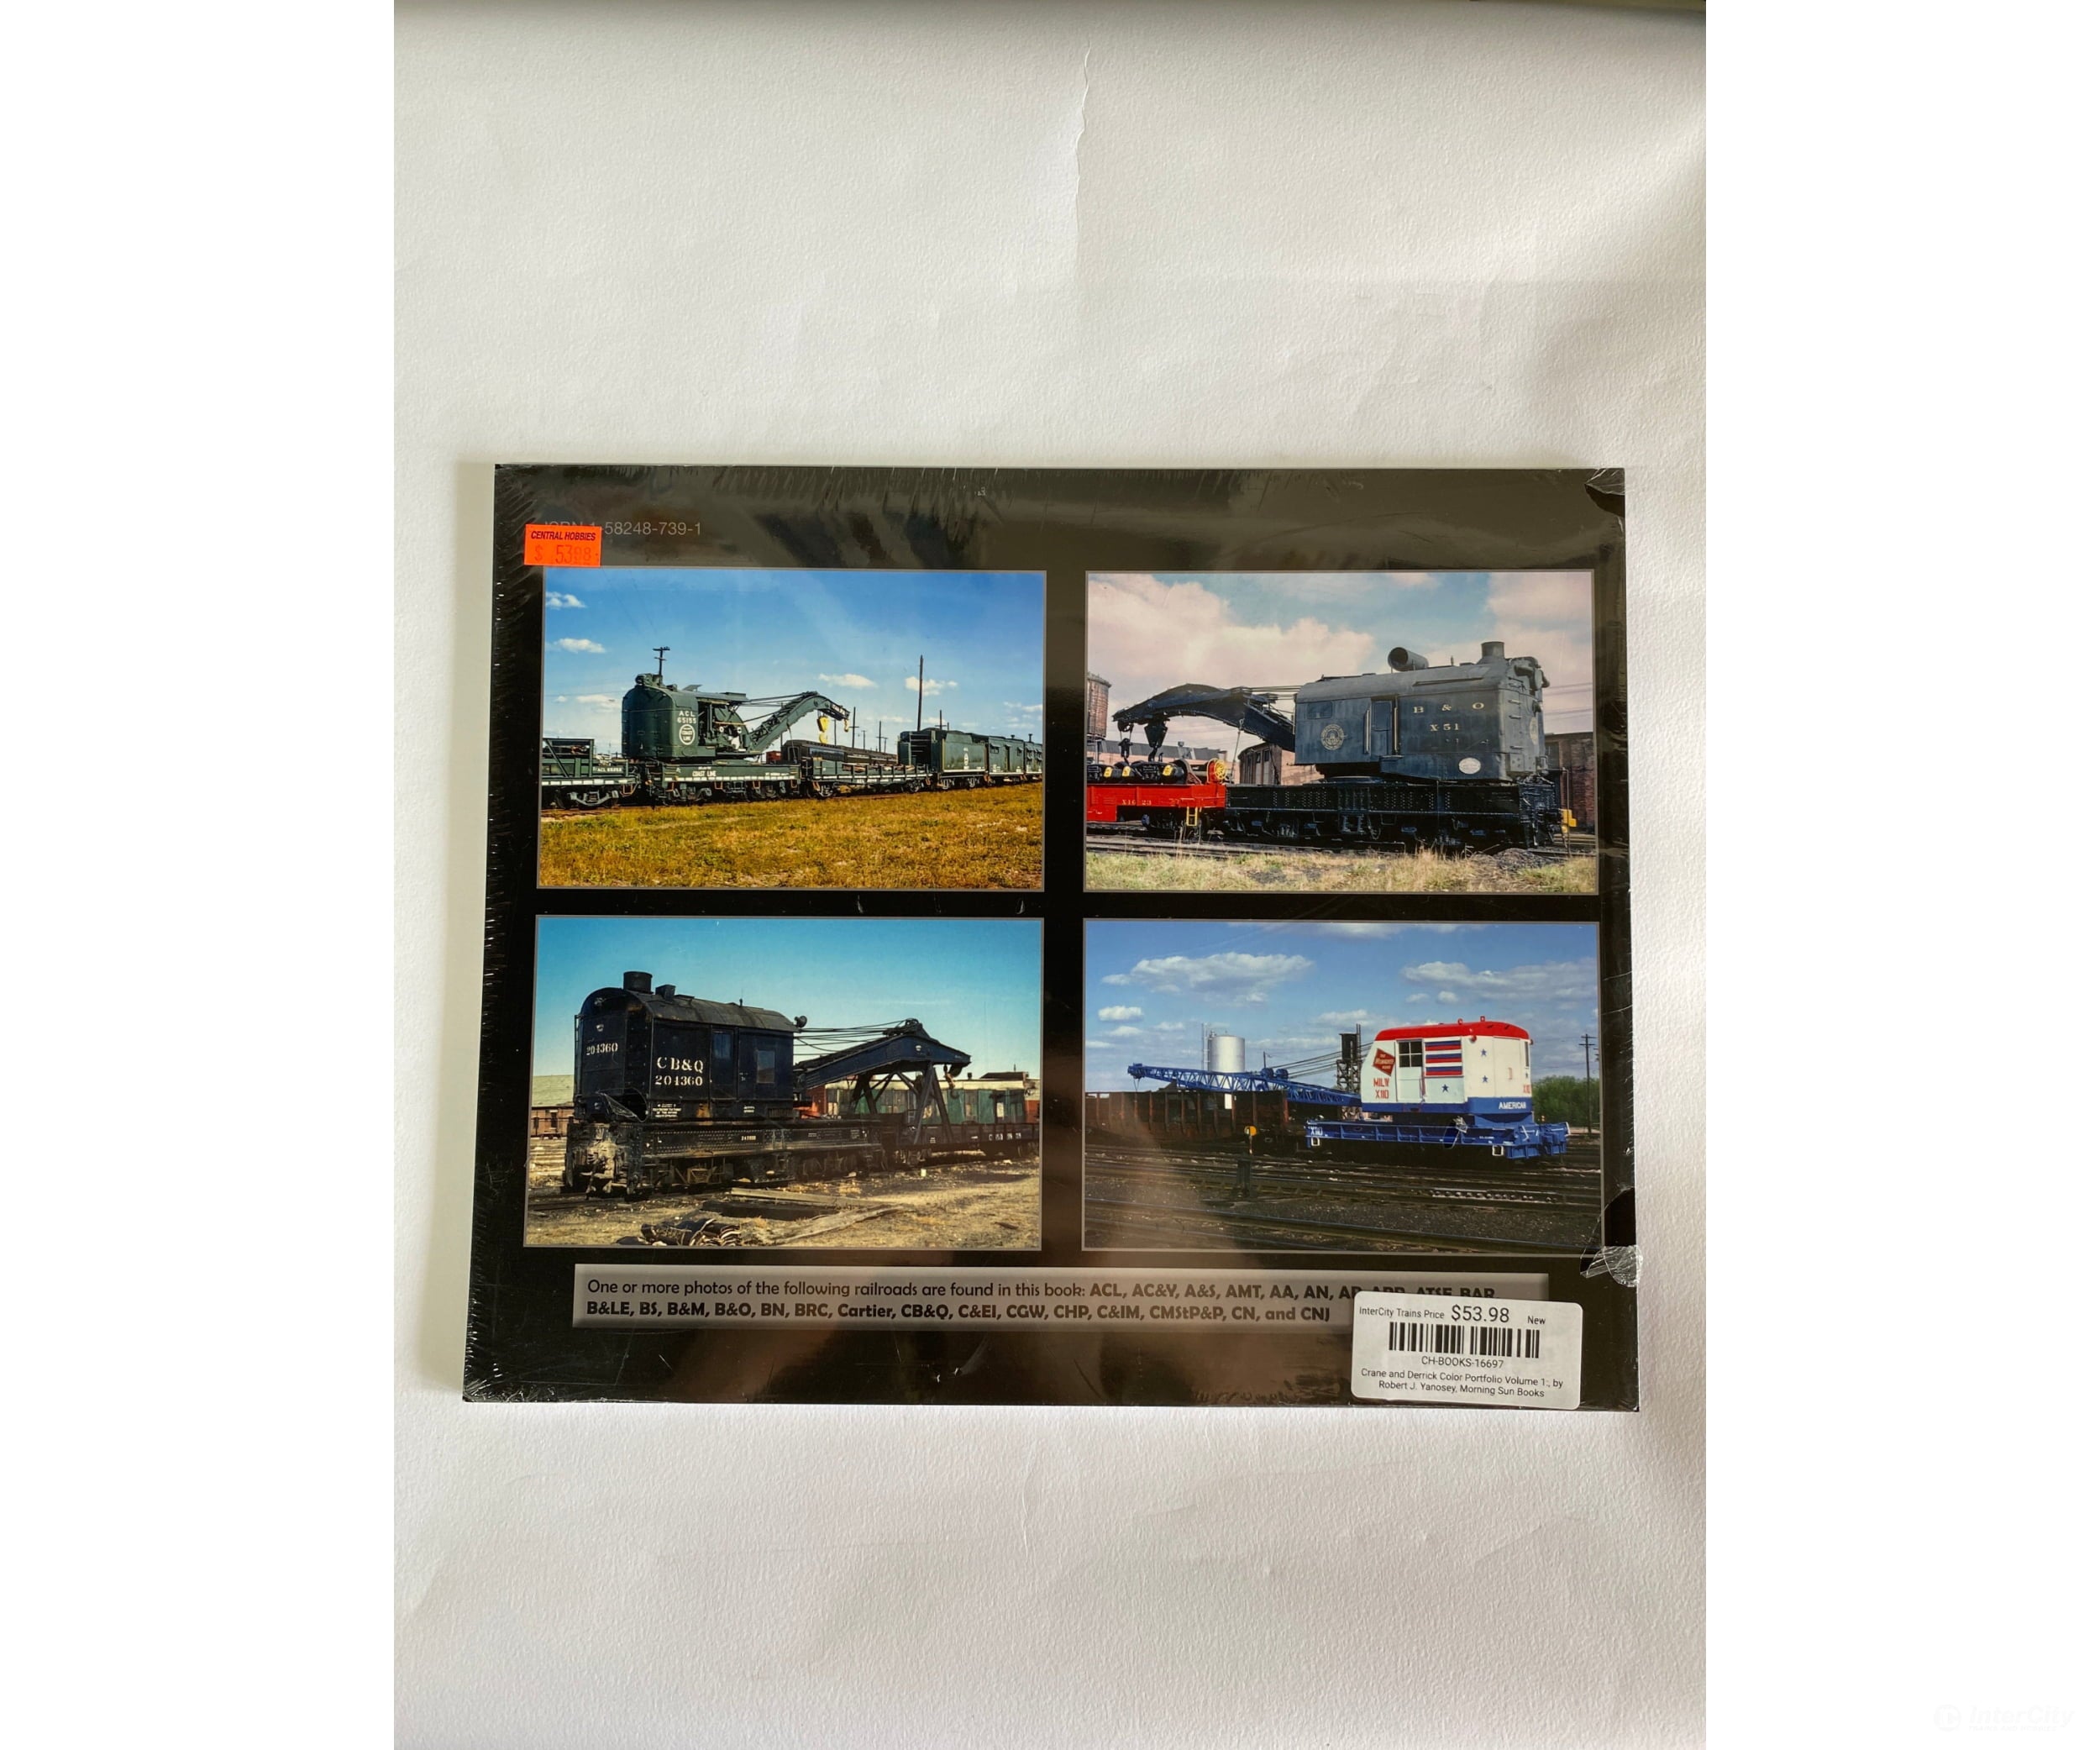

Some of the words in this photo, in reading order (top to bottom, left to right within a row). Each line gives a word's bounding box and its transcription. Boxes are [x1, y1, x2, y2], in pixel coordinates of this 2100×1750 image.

[531, 530, 563, 540] CENTRAL
[564, 532, 596, 541] HOBBIES
[589, 521, 701, 536] 58248-739-1
[588, 1279, 618, 1293] One
[622, 1283, 638, 1293] or
[642, 1283, 680, 1294] more
[685, 1280, 732, 1296] photos
[737, 1280, 752, 1295] of
[756, 1281, 780, 1295] the
[784, 1281, 850, 1297] following
[855, 1282, 917, 1295] railroads
[922, 1285, 946, 1296] are
[951, 1282, 994, 1296] found
[998, 1284, 1011, 1296] in
[1016, 1283, 1040, 1296] this
[1044, 1283, 1085, 1296] book:
[1089, 1283, 1127, 1299] ACL,
[1131, 1283, 1179, 1300] AC&Y,
[1184, 1284, 1221, 1300] A&S,
[1226, 1285, 1265, 1301] AMT,
[1269, 1285, 1299, 1301] AA,
[1304, 1285, 1334, 1301] AN,
[587, 1301, 635, 1316] B&LE,
[639, 1301, 663, 1317] BS,
[667, 1302, 710, 1317] B&M,
[715, 1302, 756, 1318] B&O,
[761, 1303, 790, 1318] BN,
[795, 1303, 833, 1318] BRC,
[837, 1304, 896, 1319] Cartier,
[901, 1304, 953, 1320] CB&Q,
[958, 1304, 1002, 1320] C&EI,
[1006, 1305, 1049, 1320] CGW,
[1053, 1305, 1093, 1321] CHP,
[1097, 1305, 1145, 1321] C&IM,
[1149, 1306, 1226, 1322] CMStP&P,
[1231, 1306, 1261, 1322] CN,
[1265, 1306, 1296, 1320] and
[1301, 1307, 1330, 1322] CNJ
[1359, 1306, 1394, 1317] InterCity
[1397, 1308, 1421, 1317] Trains
[1424, 1309, 1445, 1319] Price
[1451, 1304, 1509, 1322] $53.98
[1527, 1316, 1546, 1325] New
[1421, 1355, 1504, 1369] CH-BOOKS-16697
[1361, 1368, 1387, 1377] Crane
[1389, 1369, 1404, 1378] and
[1407, 1370, 1437, 1380] Derrick
[1440, 1372, 1463, 1381] Color
[1465, 1374, 1503, 1384] Portfolio
[1505, 1376, 1538, 1385] Volume
[1552, 1379, 1563, 1389] by
[1378, 1380, 1408, 1390] Robert
[1420, 1382, 1457, 1394] Yanosey,
[1459, 1385, 1495, 1395] Morning
[1498, 1386, 1515, 1395] Sun
[1517, 1387, 1545, 1397] Books
